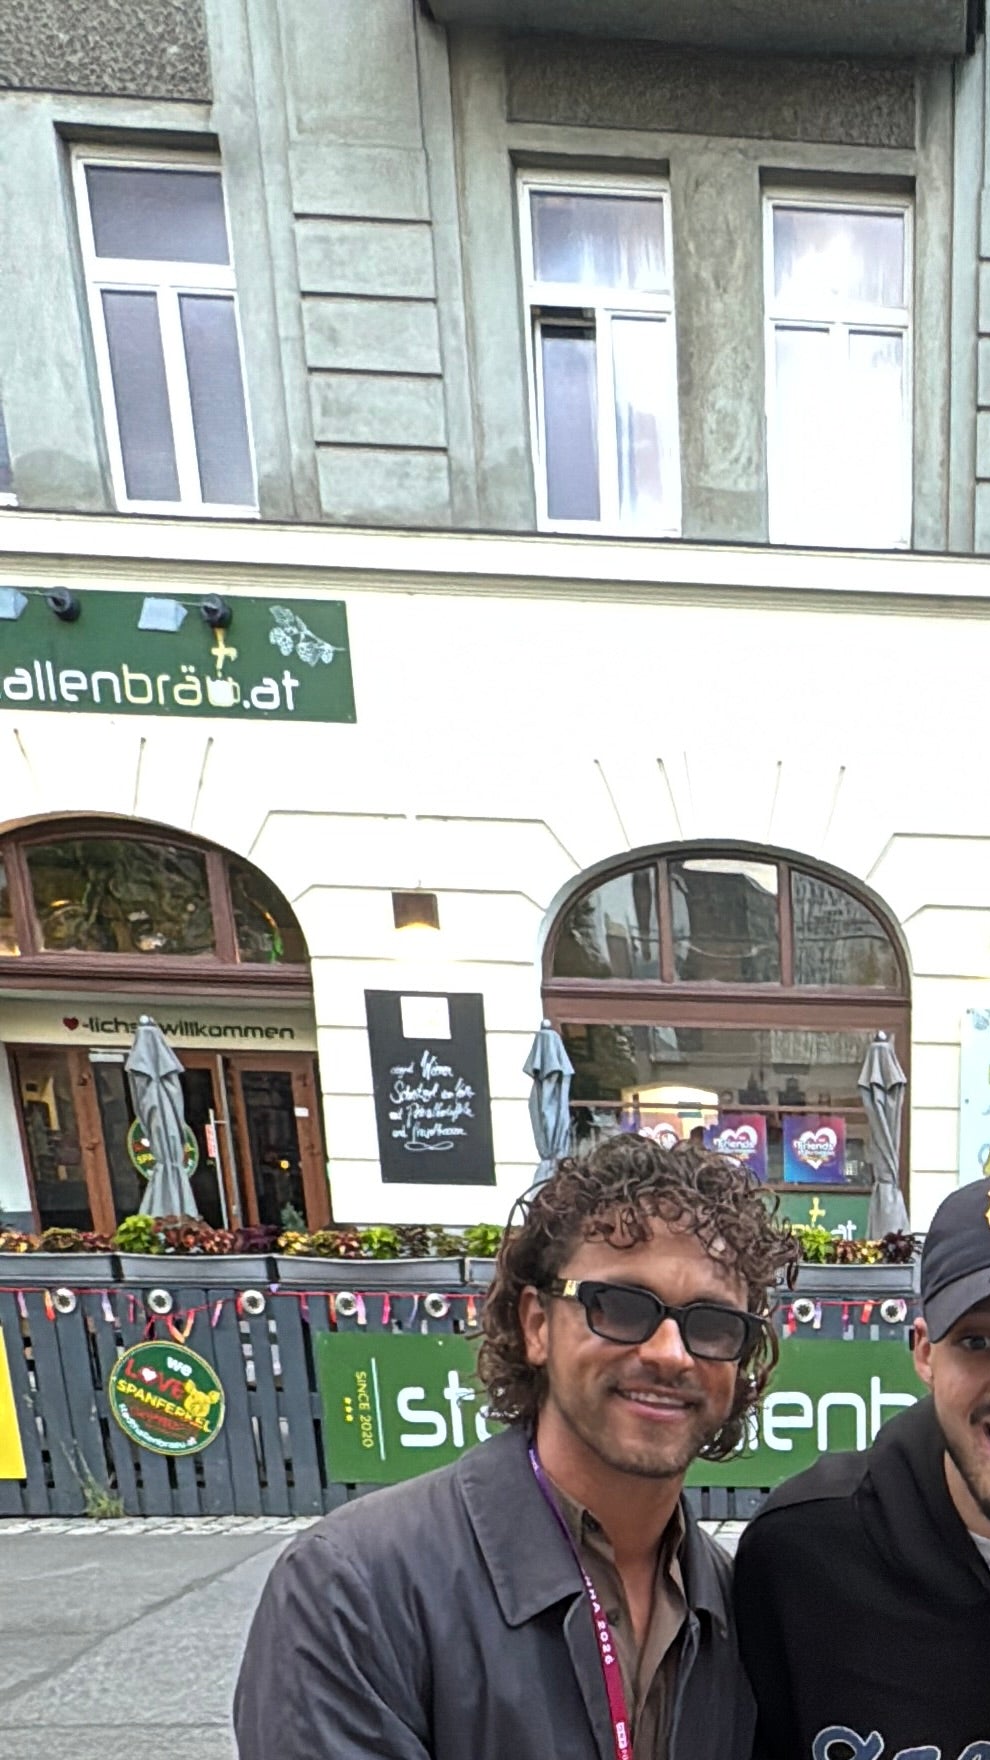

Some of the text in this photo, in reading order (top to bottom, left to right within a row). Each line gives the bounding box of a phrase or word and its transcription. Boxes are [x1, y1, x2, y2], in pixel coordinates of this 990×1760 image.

[166, 1356, 193, 1377] we
[355, 1371, 375, 1449] SINCE 2020
